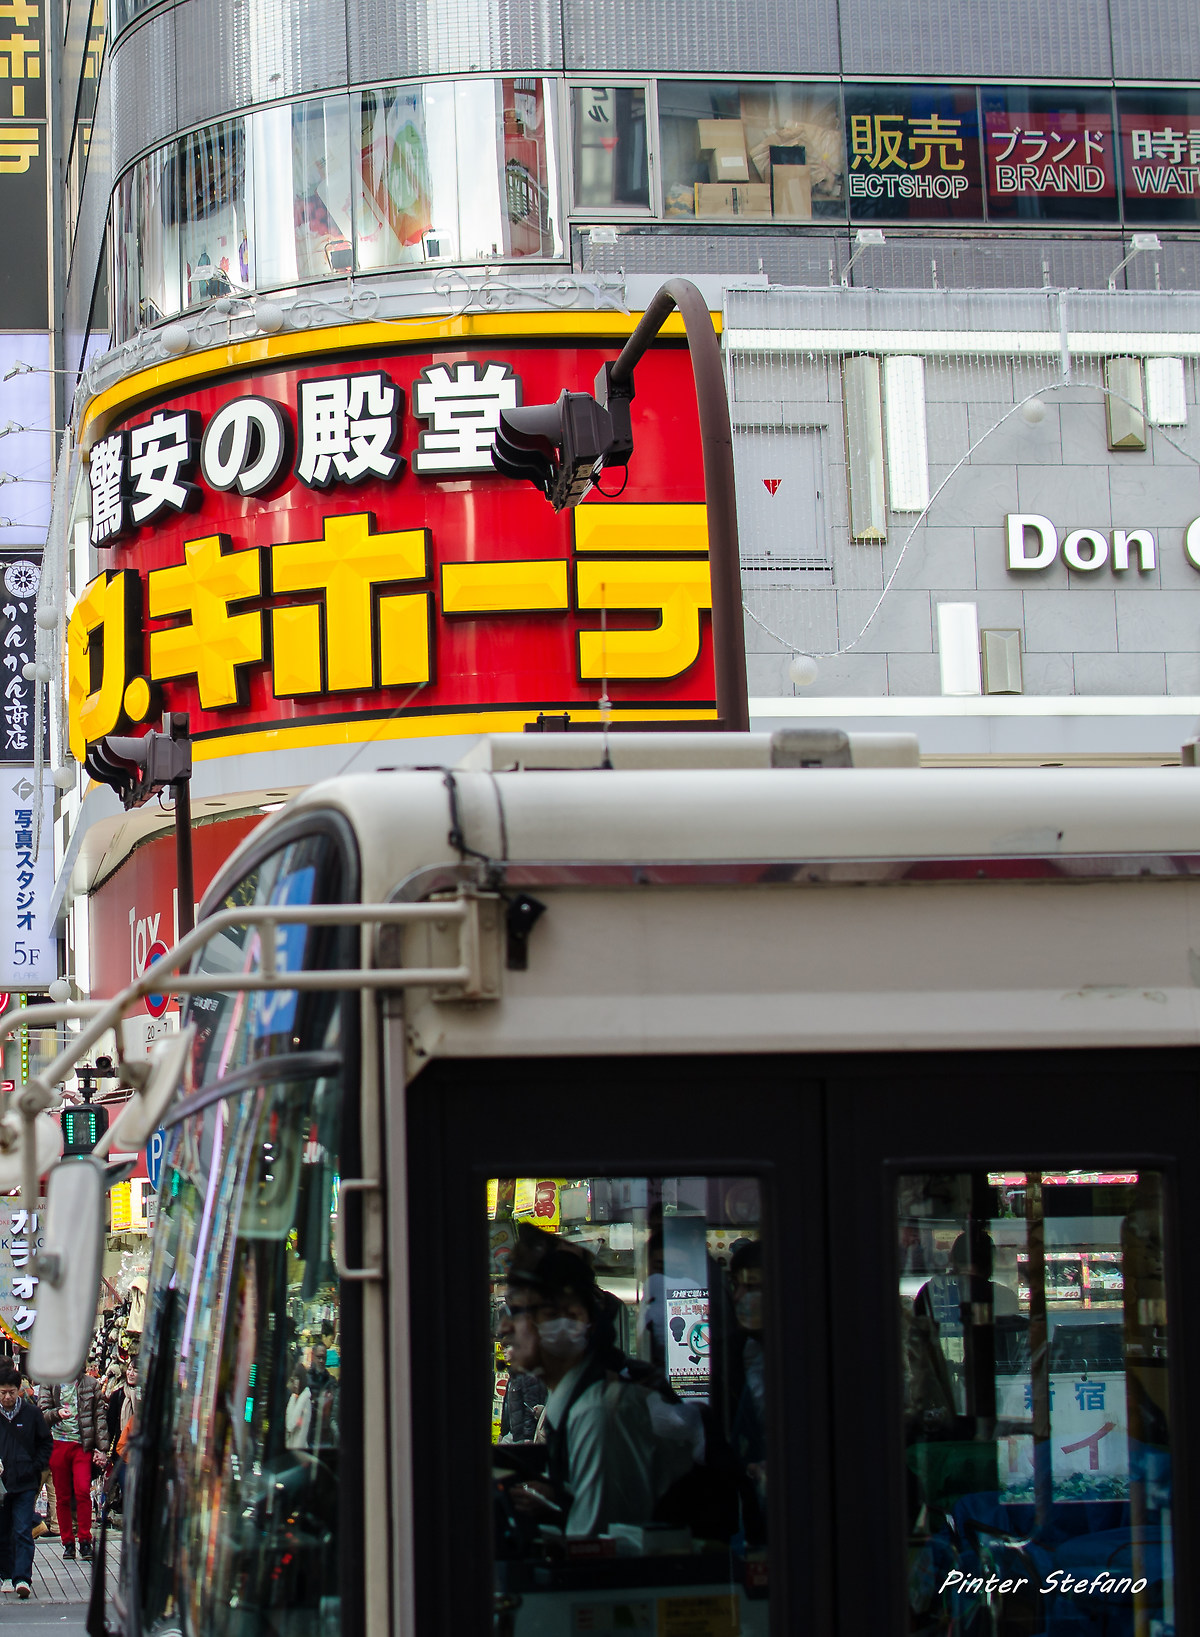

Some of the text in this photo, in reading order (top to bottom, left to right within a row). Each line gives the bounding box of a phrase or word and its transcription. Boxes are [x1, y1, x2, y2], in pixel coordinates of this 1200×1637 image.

[851, 114, 965, 171] 販売
[992, 127, 1104, 164] ブランド
[849, 174, 969, 198] ECTSHOP
[996, 165, 1105, 192] BRAND
[1133, 166, 1200, 194] WAT
[89, 363, 518, 543] 驚安の殿堂
[1003, 512, 1156, 571] Don
[2, 601, 30, 751] かんかん商店
[14, 809, 37, 930] 写真スタジオ
[13, 941, 41, 967] 5F
[10, 1209, 38, 1332] カラオケ
